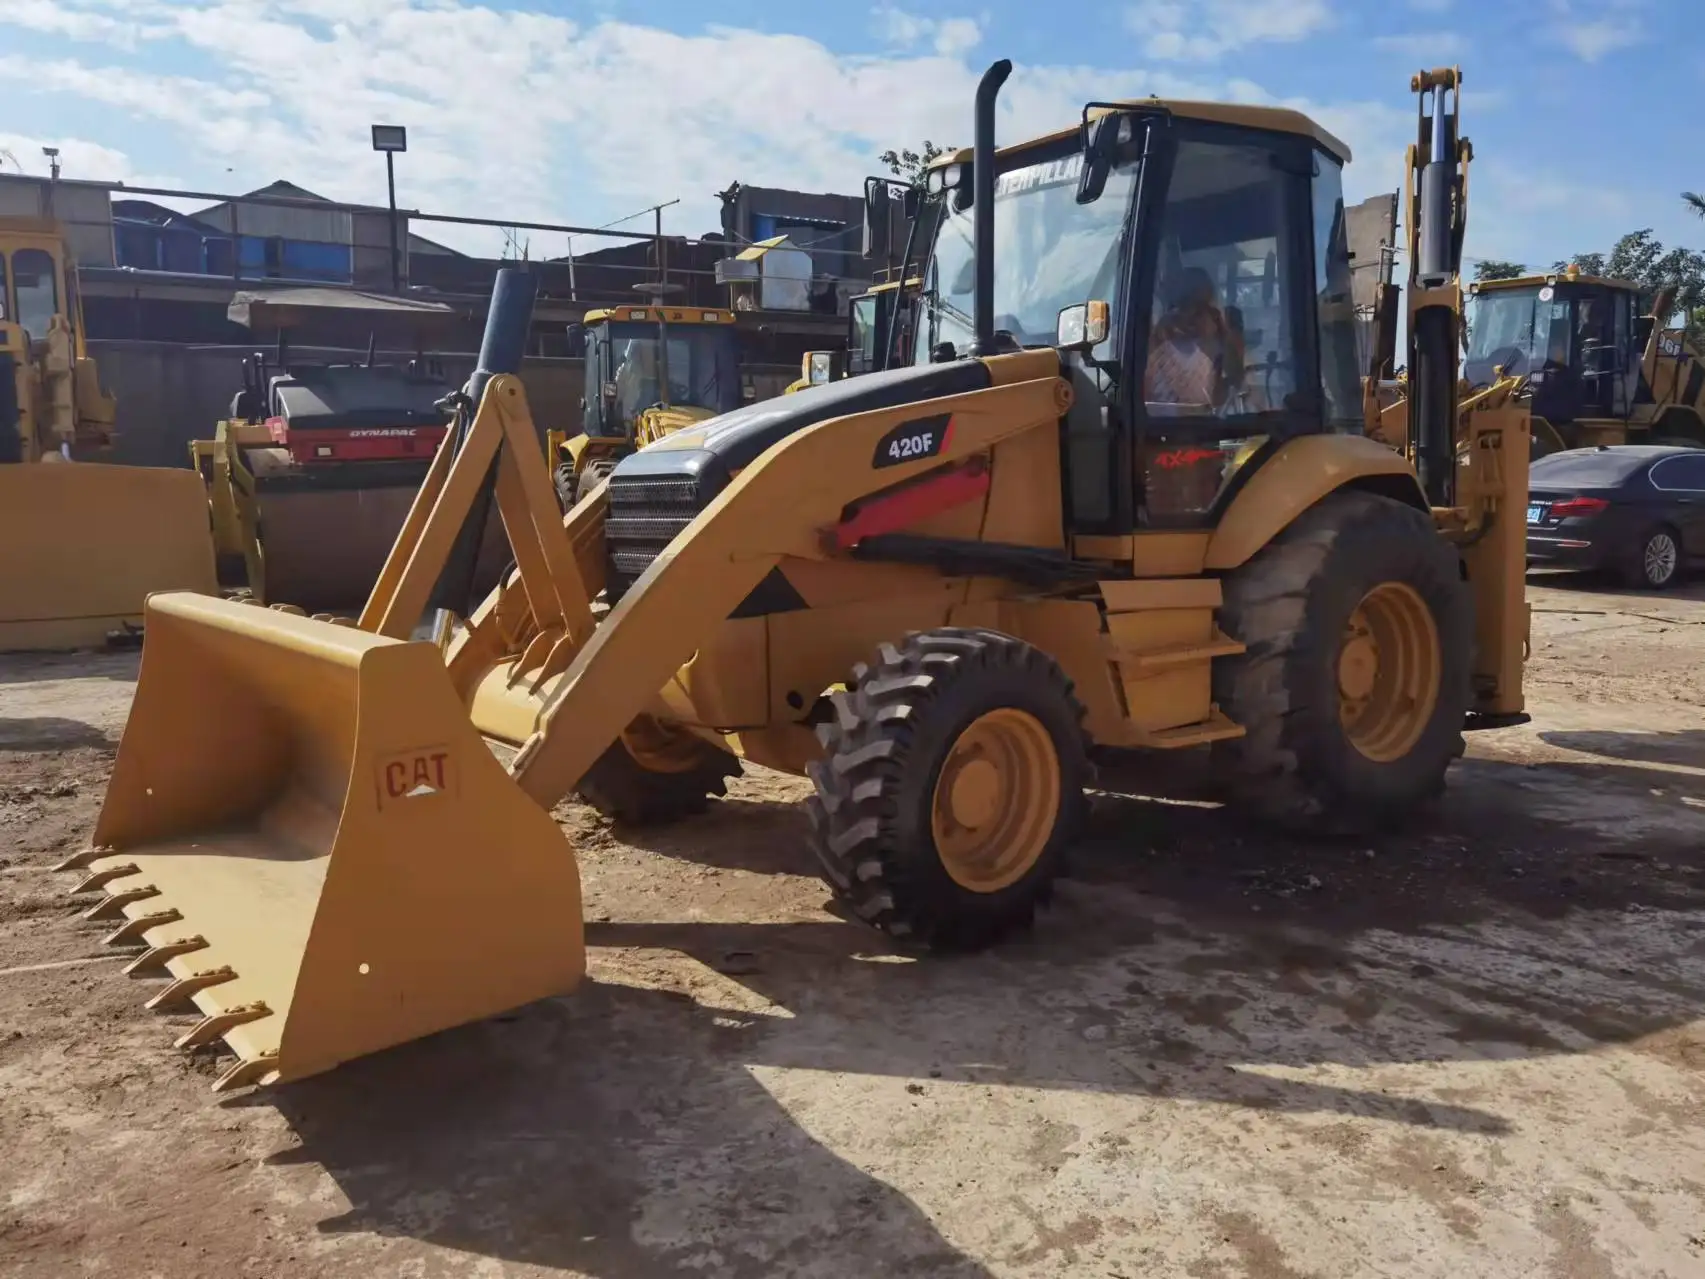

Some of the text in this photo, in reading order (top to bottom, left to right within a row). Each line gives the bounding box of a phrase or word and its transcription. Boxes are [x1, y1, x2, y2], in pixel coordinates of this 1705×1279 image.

[349, 429, 417, 437] DYNAPAC
[888, 432, 933, 458] 420F
[386, 752, 448, 797] CAT
